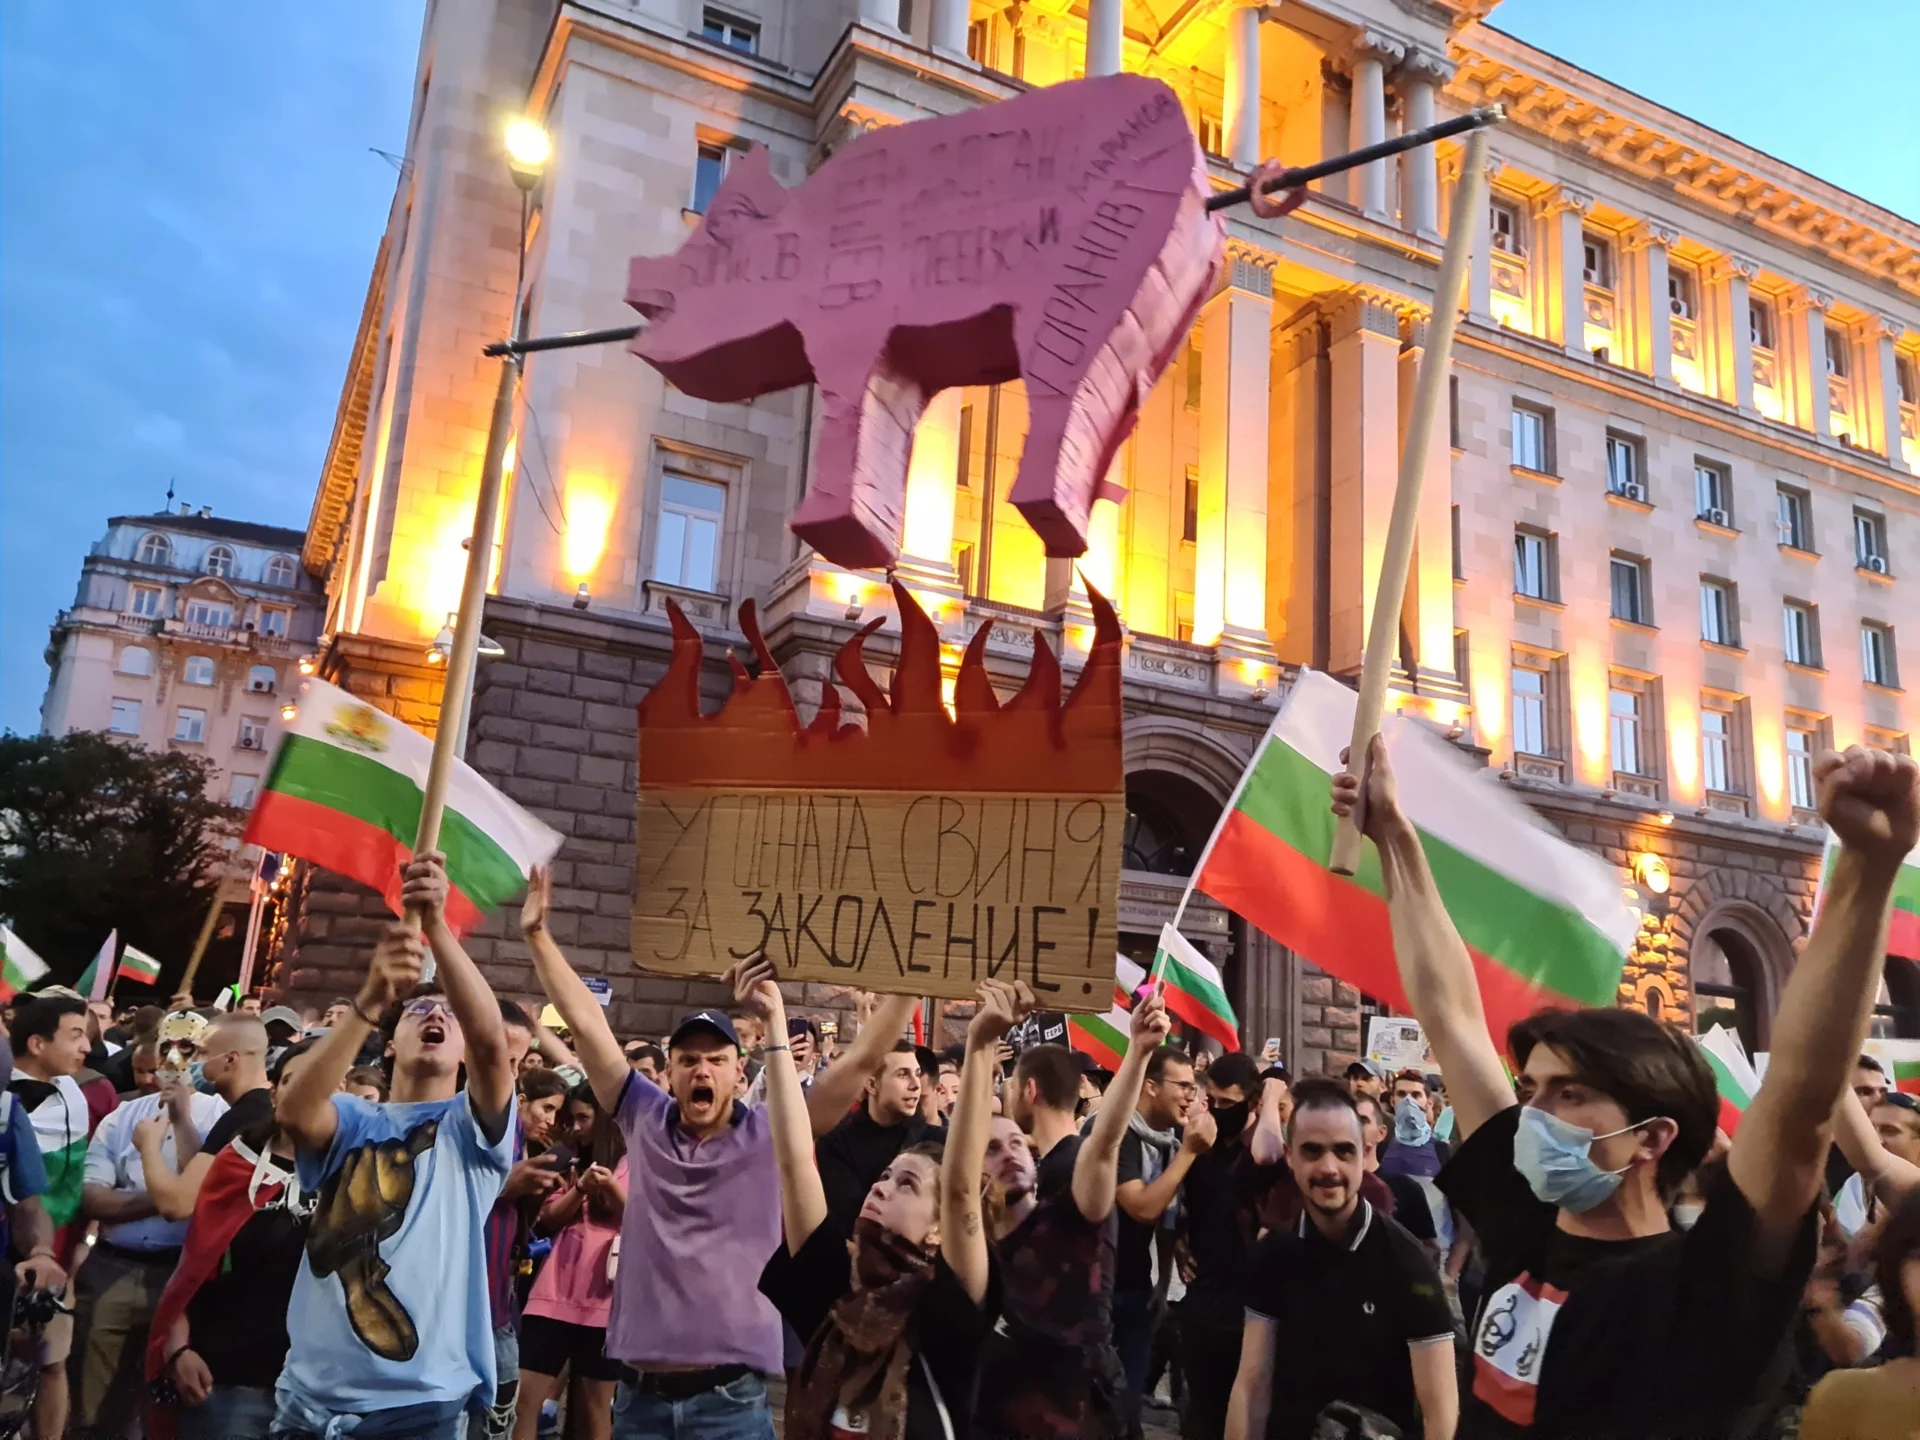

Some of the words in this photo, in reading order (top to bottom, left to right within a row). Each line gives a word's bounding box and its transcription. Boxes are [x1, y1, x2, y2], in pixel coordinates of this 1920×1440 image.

[1026, 201, 1145, 397] ГОРАНОВ
[650, 794, 877, 892] УГОЕНАТА
[901, 795, 1106, 903] СВИНЯ
[653, 886, 716, 961] ЗА
[728, 891, 1099, 995] ЗАКОЛЕНИЕ!
[1045, 1024, 1063, 1039] ГЕРБ
